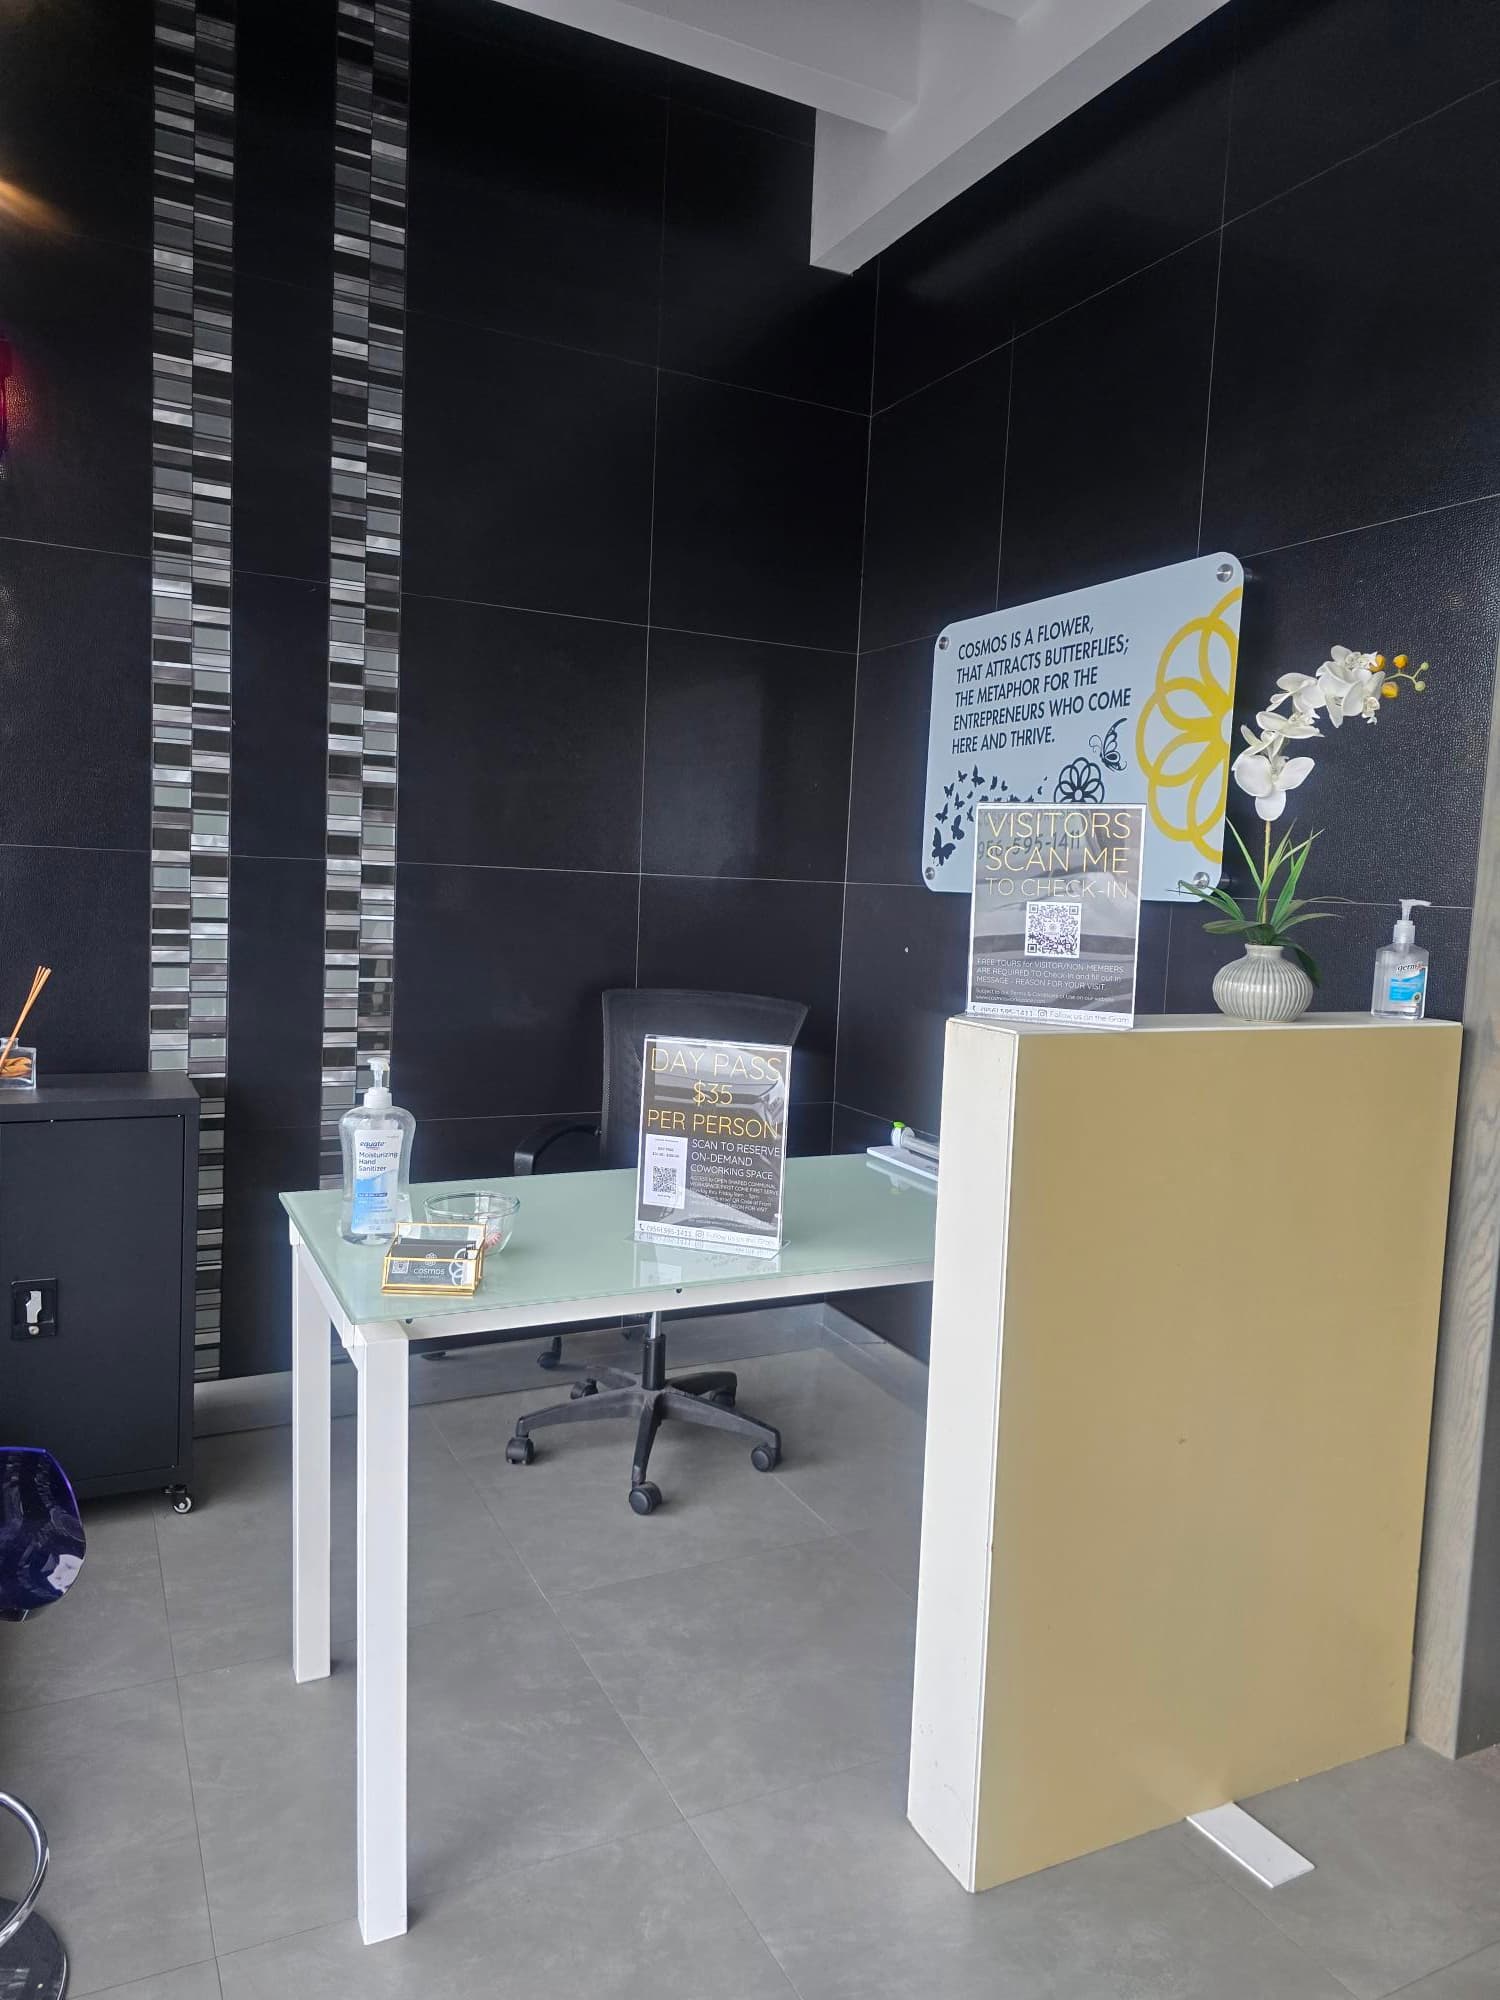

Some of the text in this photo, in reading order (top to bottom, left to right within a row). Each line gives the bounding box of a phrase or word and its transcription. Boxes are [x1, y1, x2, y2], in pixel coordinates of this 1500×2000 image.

[958, 615, 1094, 660] COSMOS IS A FLOWER,
[957, 634, 1129, 684] THAT ATTRACTS BUTTERFLIES;
[955, 666, 1098, 707] THE METAPHOR FOR THE
[953, 688, 1131, 731] ENTREPRENEURS WHO COME
[952, 726, 1055, 754] HERE AND THRIVE.
[987, 812, 1131, 839] VISITORS
[985, 845, 1130, 873] SCAN ME
[985, 877, 1128, 898] TO CHECK-IN
[976, 967, 991, 975] ARE
[992, 968, 1029, 977] REQUIRED
[977, 958, 995, 966] FREE
[997, 959, 1021, 968] TOURS
[976, 975, 1009, 985] MESSAGE
[1015, 978, 1046, 986] REASON
[1047, 980, 1063, 988] FOR
[1065, 981, 1085, 990] YOUR
[1086, 983, 1106, 991] VISIT
[651, 1047, 783, 1081] DAY PASS
[692, 1079, 733, 1107] $35
[648, 1109, 778, 1140] PER PERSON
[359, 1151, 399, 1159] Moisturizing
[691, 1151, 753, 1167] ON-DEMAND
[692, 1138, 718, 1150] SCAN
[720, 1141, 735, 1152] TO
[736, 1143, 781, 1157] RESERVE
[690, 1163, 773, 1180] COWORKING SPACE
[413, 1267, 446, 1275] cosmos
